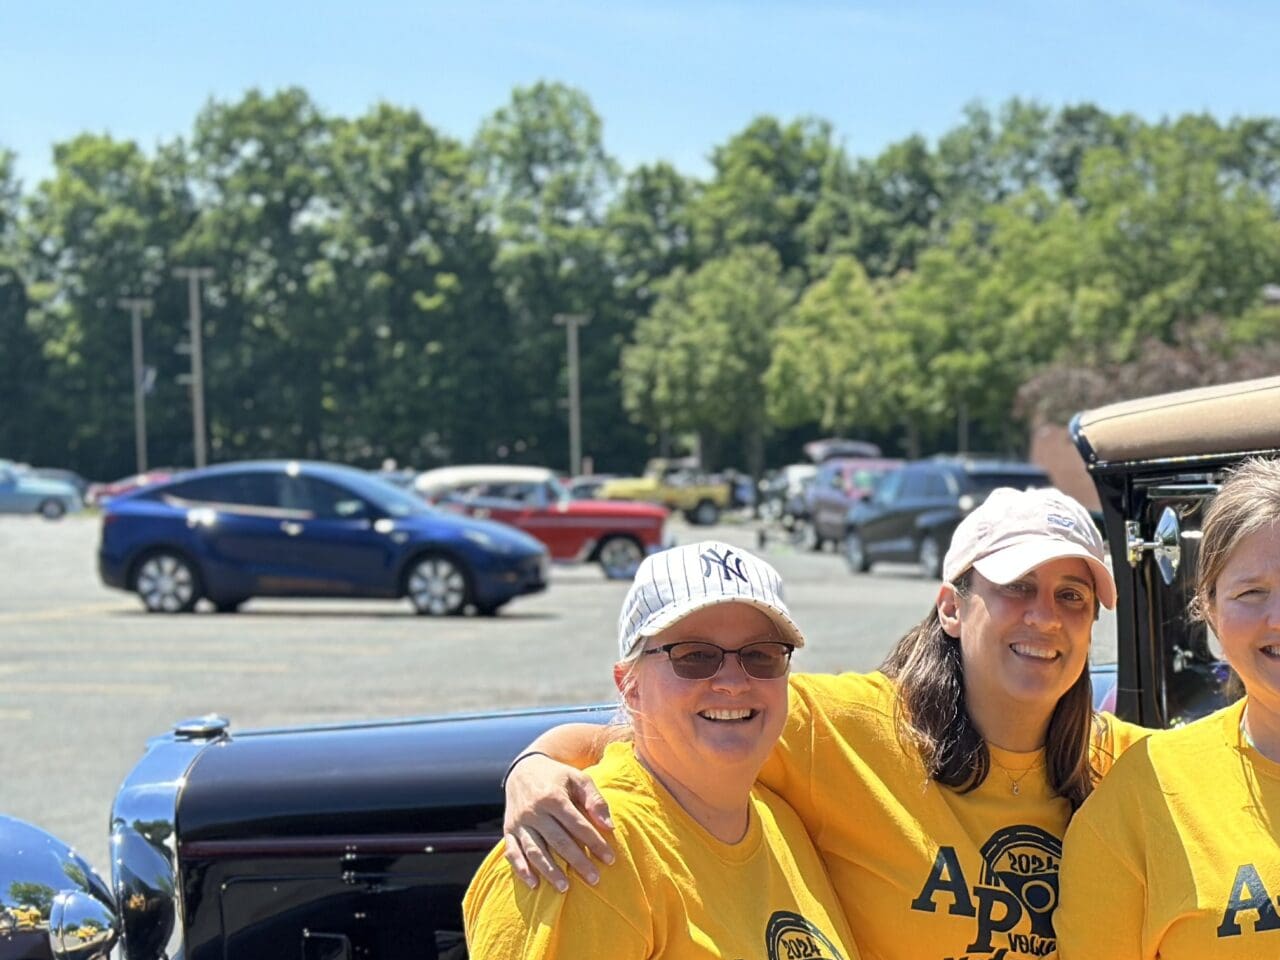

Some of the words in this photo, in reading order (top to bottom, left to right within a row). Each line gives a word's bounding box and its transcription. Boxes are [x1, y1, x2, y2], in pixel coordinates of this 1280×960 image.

[700, 548, 748, 582] NY
[911, 846, 1023, 953] AP
[782, 935, 820, 958] 2024
